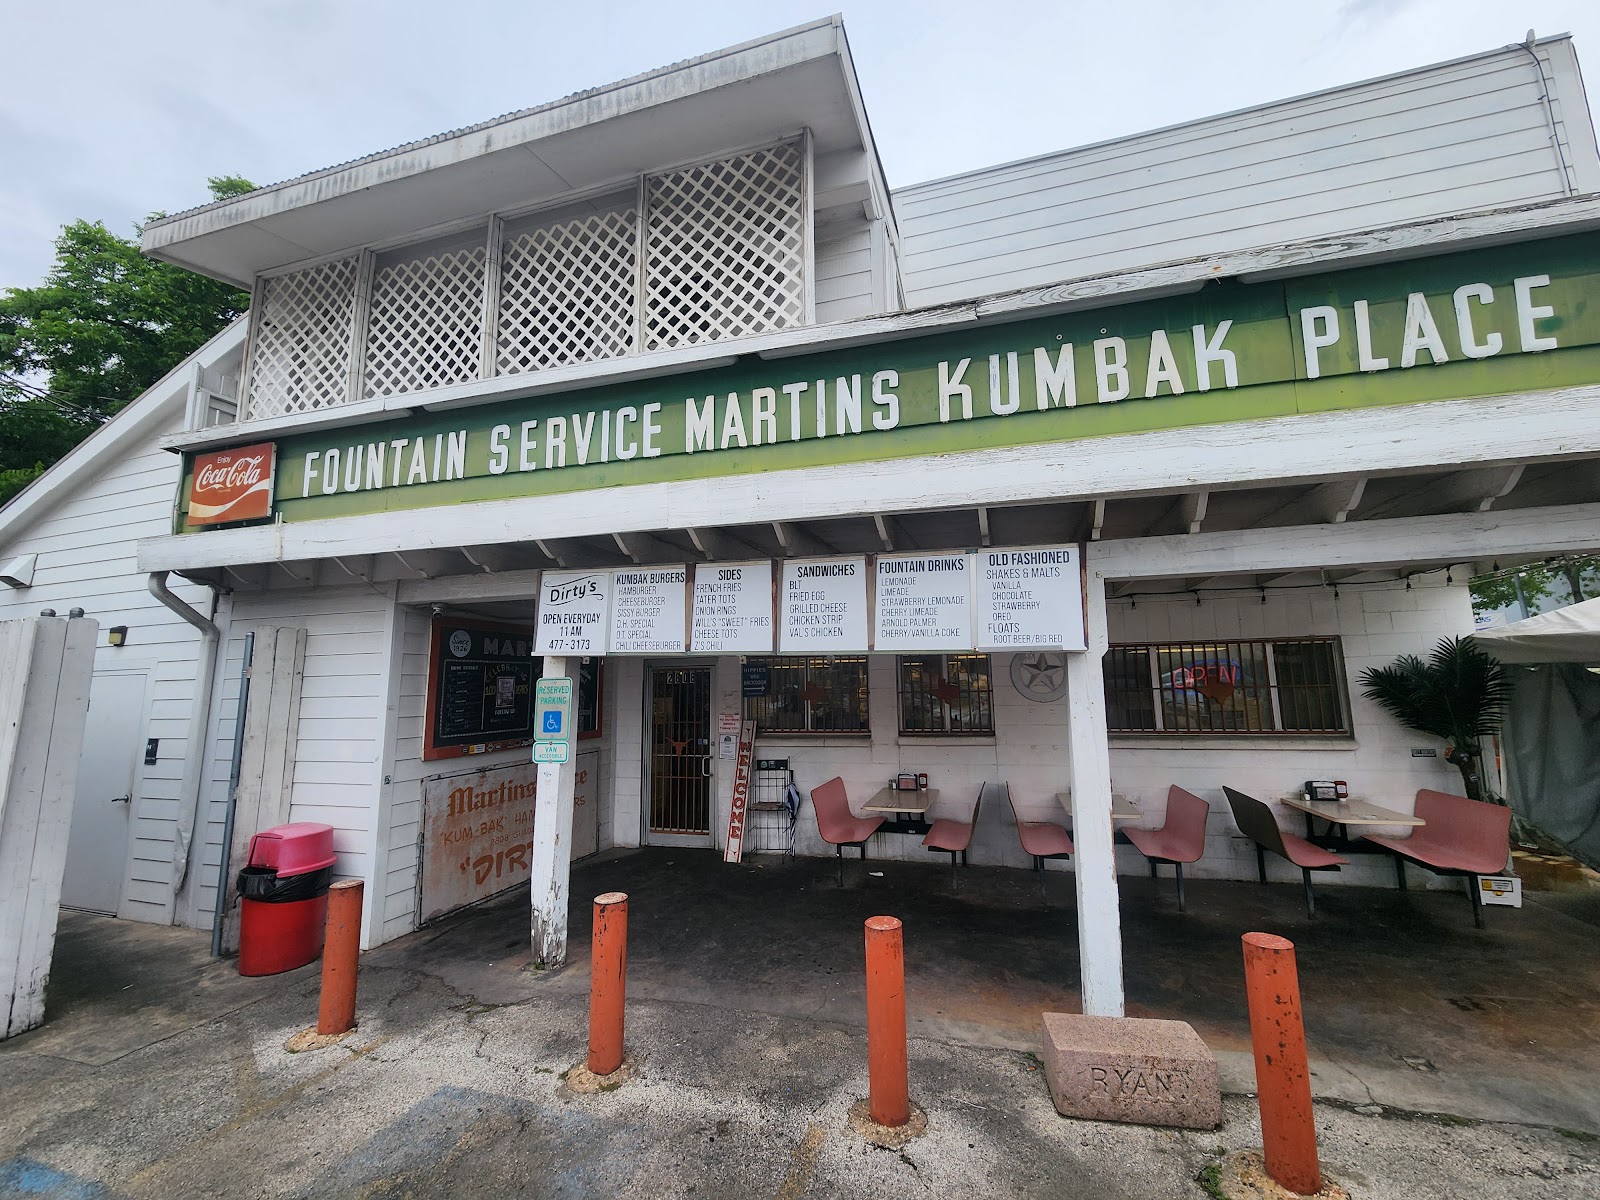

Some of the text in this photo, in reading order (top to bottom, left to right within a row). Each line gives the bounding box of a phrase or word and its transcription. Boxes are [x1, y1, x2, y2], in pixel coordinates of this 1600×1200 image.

[302, 274, 1558, 497] FOUNTAIN SERVICE MARTINS KUMBAK PLACE
[217, 456, 232, 464] Enjoy
[196, 454, 265, 493] Coca-Cola
[989, 551, 1069, 566] OLD FASHIONED
[798, 564, 854, 577] SANDWICHES
[880, 559, 964, 573] FOUNTAIN DRINKS
[617, 572, 685, 584] KUMBAK BURGERS
[719, 569, 741, 580] SIDES
[987, 567, 1060, 579] SHAKES & MALTS
[790, 580, 802, 589] BLT
[882, 577, 916, 586] LEMONADE
[992, 581, 1021, 589] VANILLA
[551, 581, 596, 602] Dirty's
[619, 586, 656, 595] HAMBURGER
[697, 583, 741, 592] FRENCH FRIES
[881, 588, 909, 596] LIMEADE
[696, 594, 735, 604] TATER TOTS
[790, 591, 825, 601] FRIED EGG
[992, 591, 1032, 600] CHOCOLATE
[618, 597, 665, 606] CHEESEBURGER
[882, 596, 964, 606] STRAWBERRY LEMONADE
[993, 601, 1040, 610] STRAWBERRY
[618, 608, 660, 617] SISSY BURGER
[696, 606, 736, 615] ONION RINGS
[790, 603, 847, 613] GRILLED CHEESE
[882, 607, 938, 616] CHERRY LIMEADE
[543, 613, 600, 624] OPEN EVERYDAY
[789, 615, 843, 625] CHICKEN STRIP
[993, 612, 1011, 621] OREO
[631, 619, 655, 628] SPECIAL
[695, 618, 716, 627] WILL'S
[750, 617, 769, 626] FRIES
[882, 618, 936, 627] ARNOLD PALMER
[560, 626, 581, 636] 11 AM
[790, 627, 842, 637] VAL'S CHICKEN
[882, 628, 960, 638] CHERRY/VANILLA COKE
[988, 623, 1019, 633] FLOATS
[628, 630, 652, 639] SPECIAL
[695, 629, 737, 638] CHEESE TOTS
[994, 635, 1011, 643] ROOT
[1049, 634, 1062, 643] RED
[452, 635, 469, 645] Since
[616, 641, 680, 650] CHILI CHEESEBURGER
[707, 641, 722, 650] CHILI
[538, 686, 569, 694] RESERVED
[730, 741, 752, 839] WELCOME
[490, 834, 509, 847] 2808
[1091, 1067, 1171, 1097] RYAN
